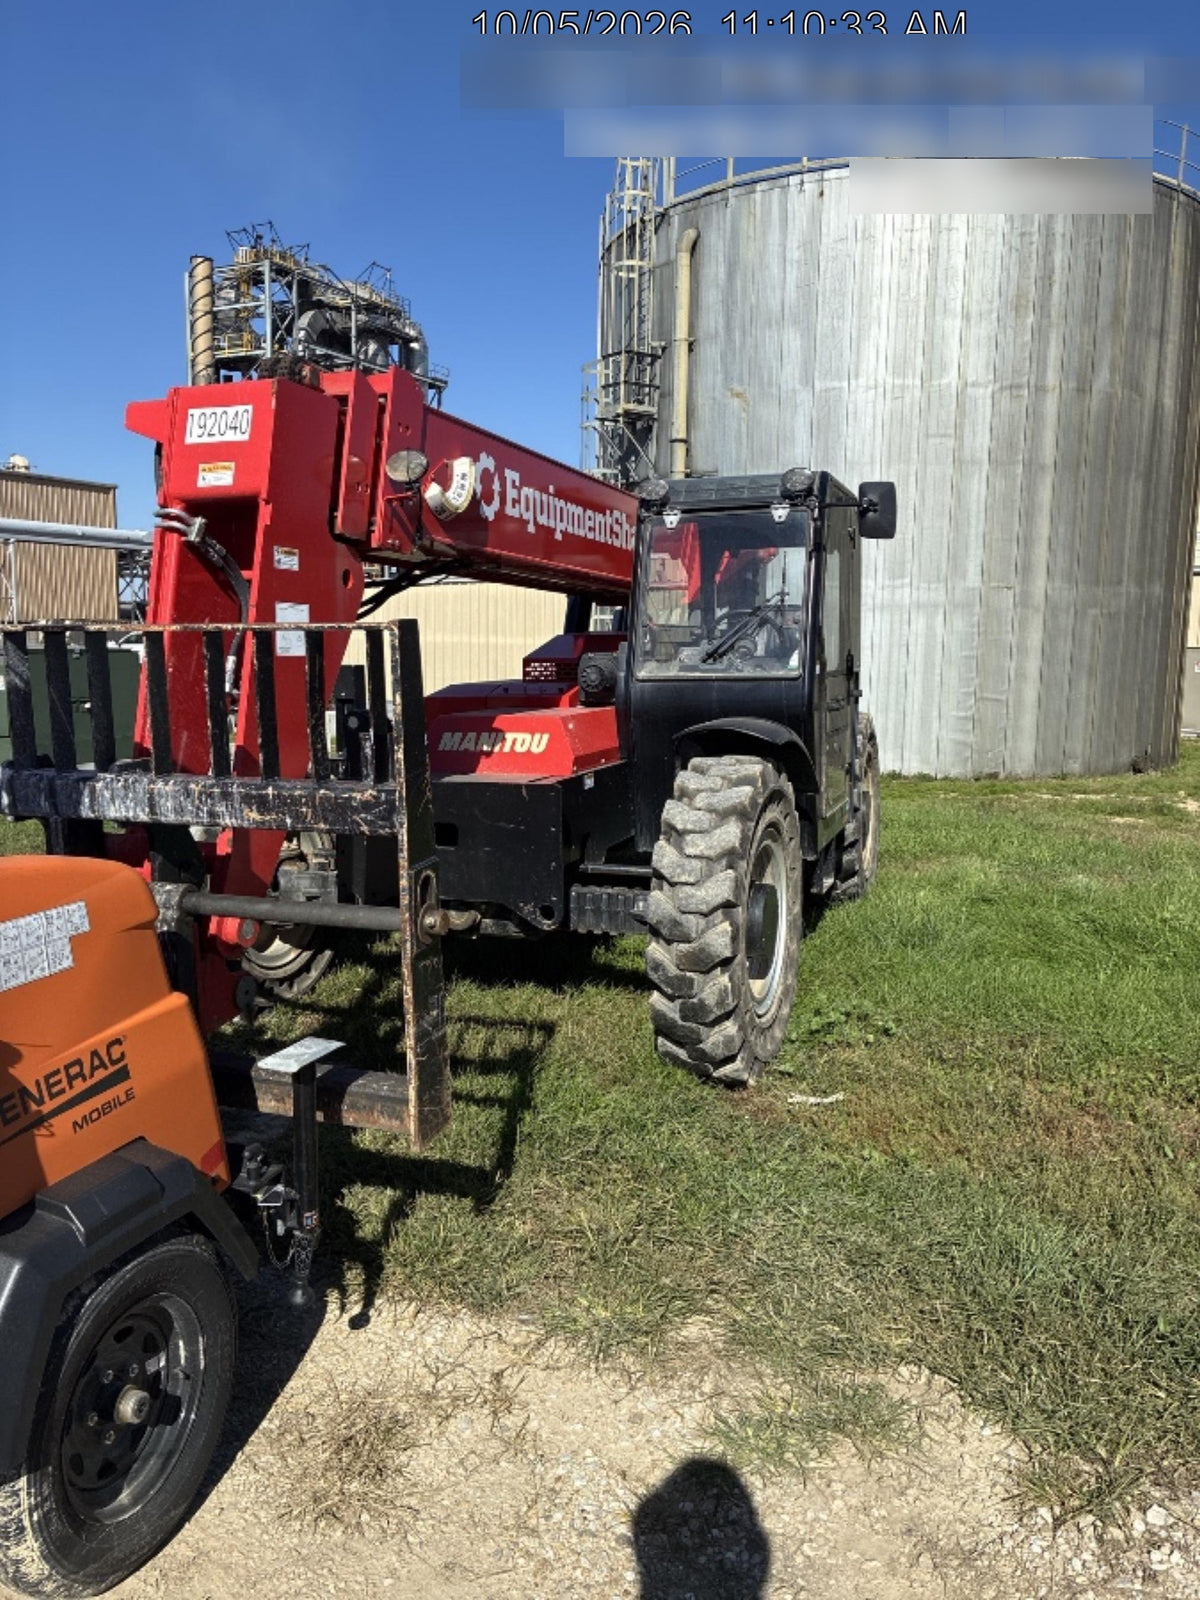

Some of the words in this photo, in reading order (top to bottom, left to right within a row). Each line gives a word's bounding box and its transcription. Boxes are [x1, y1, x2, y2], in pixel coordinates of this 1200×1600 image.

[438, 731, 549, 754] MANITOU
[0, 1037, 126, 1127] ENERAC
[72, 1087, 136, 1134] MOBILE
